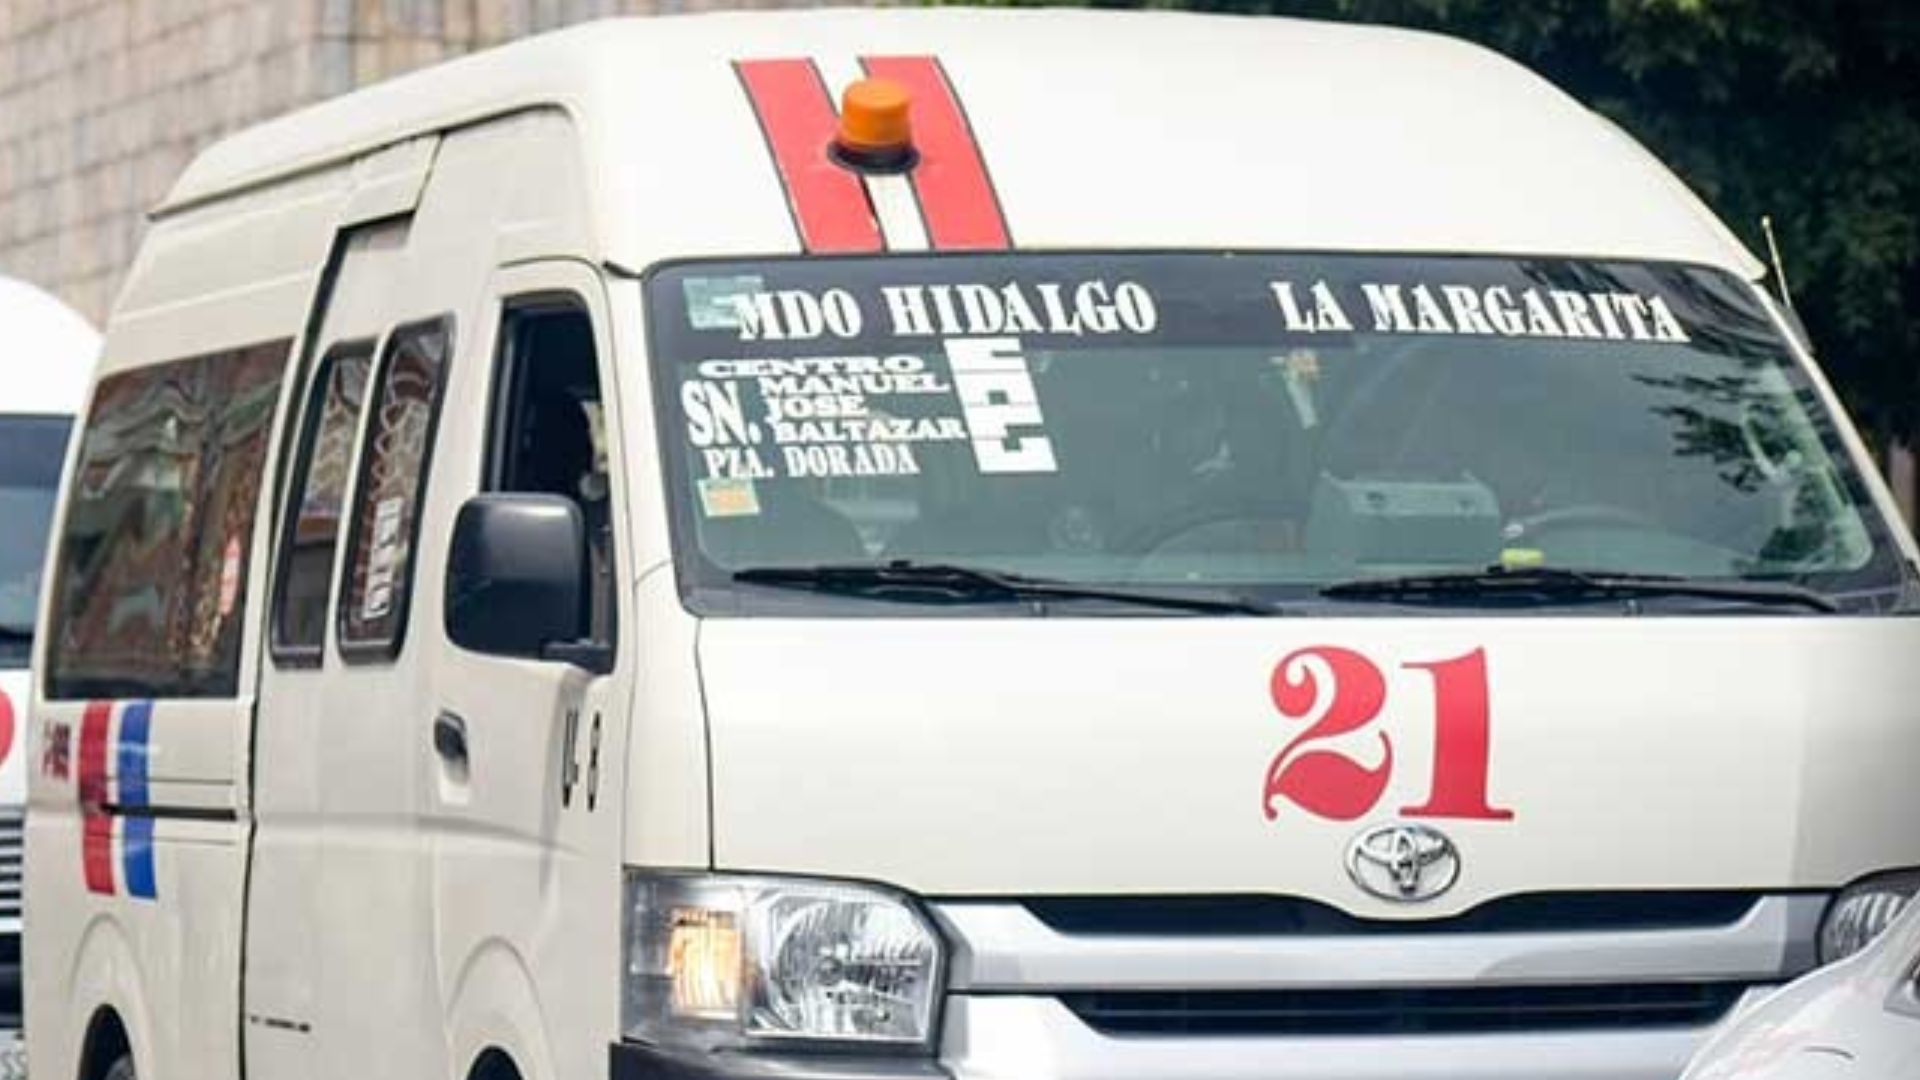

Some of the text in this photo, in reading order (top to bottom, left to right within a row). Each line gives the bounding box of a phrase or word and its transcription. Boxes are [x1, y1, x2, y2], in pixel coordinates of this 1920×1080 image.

[736, 279, 1158, 340] MDO HIDALGO
[1270, 279, 1691, 343] LA MARGARITA
[699, 356, 925, 378] CENTRO
[758, 372, 951, 394] MANUEL
[681, 379, 763, 446] SN.
[763, 394, 869, 424] JOSE
[774, 417, 967, 444] BALTAZAR
[703, 444, 921, 480] PZA. DORADA
[1263, 645, 1515, 821] 21
